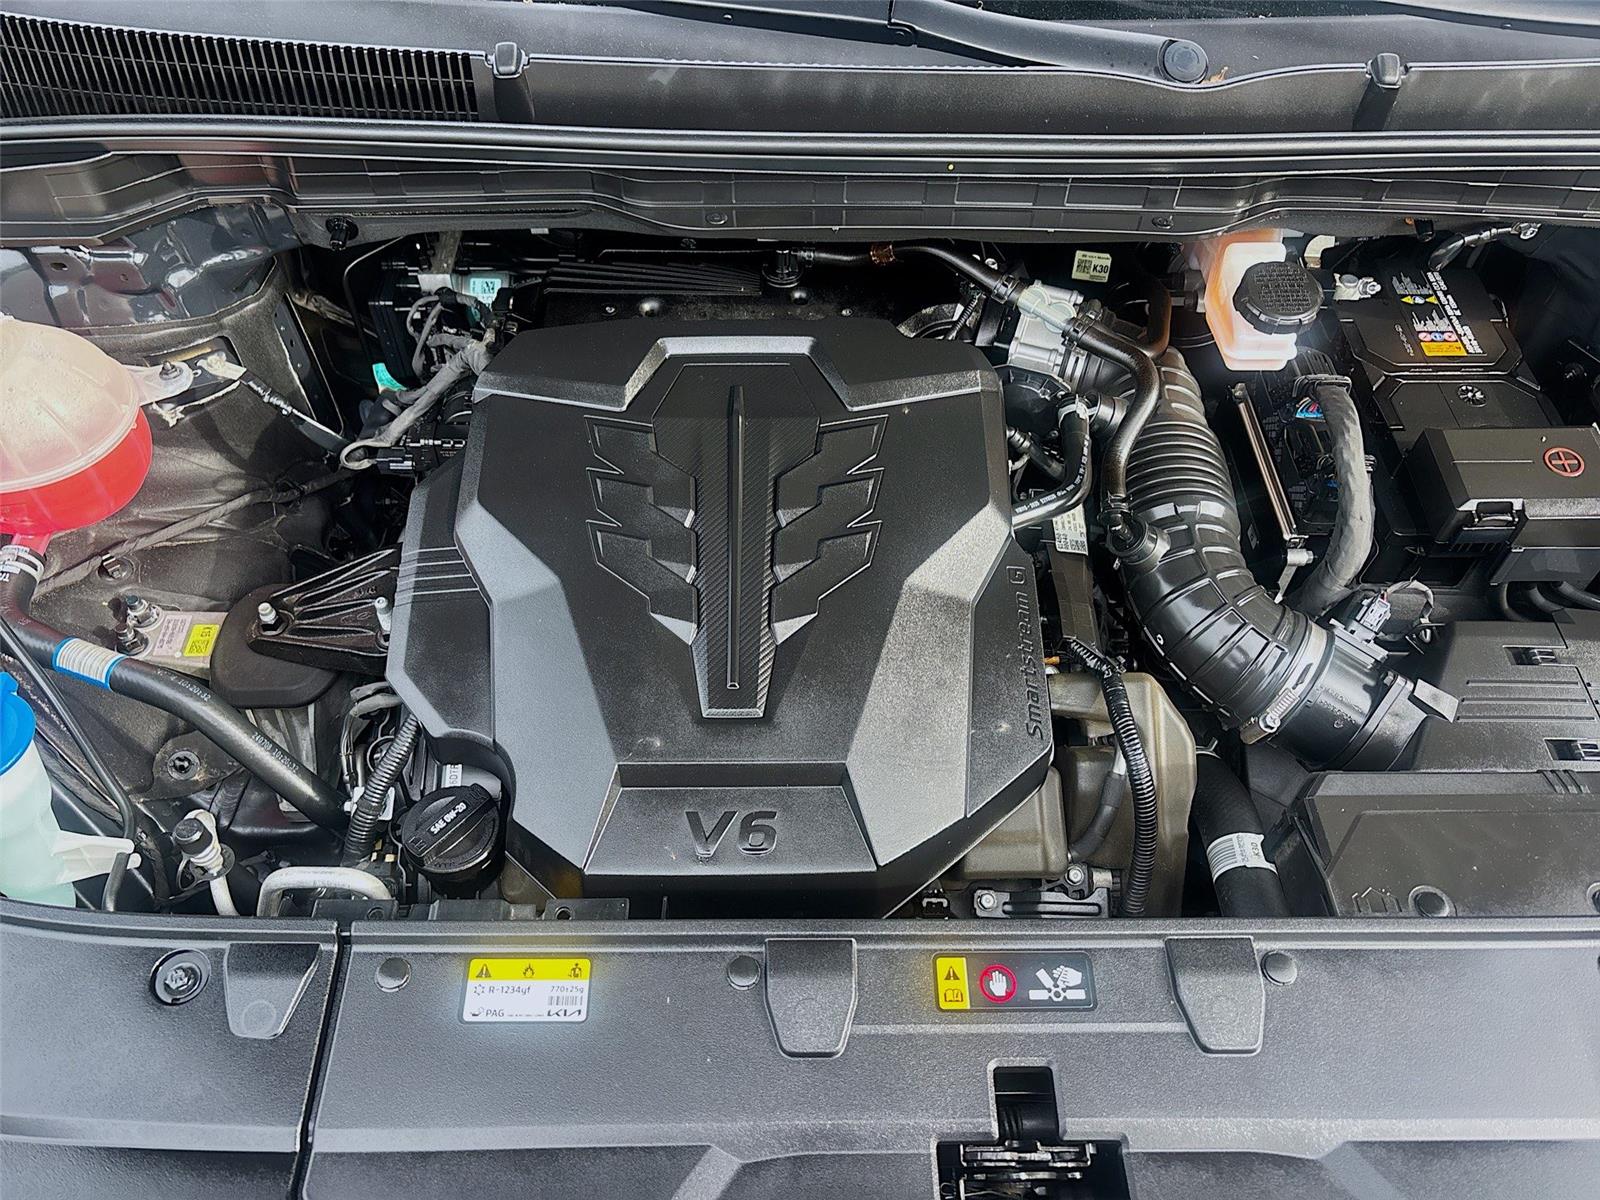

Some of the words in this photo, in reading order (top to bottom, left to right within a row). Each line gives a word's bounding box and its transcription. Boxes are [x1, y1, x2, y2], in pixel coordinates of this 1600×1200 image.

[1092, 263, 1109, 274] K30
[1015, 591, 1044, 741] Smartstream
[430, 818, 447, 834] SAE
[443, 802, 467, 823] 0W-20
[685, 810, 777, 857] V6
[488, 985, 531, 995] R-1234yf
[485, 1008, 505, 1017] PAG
